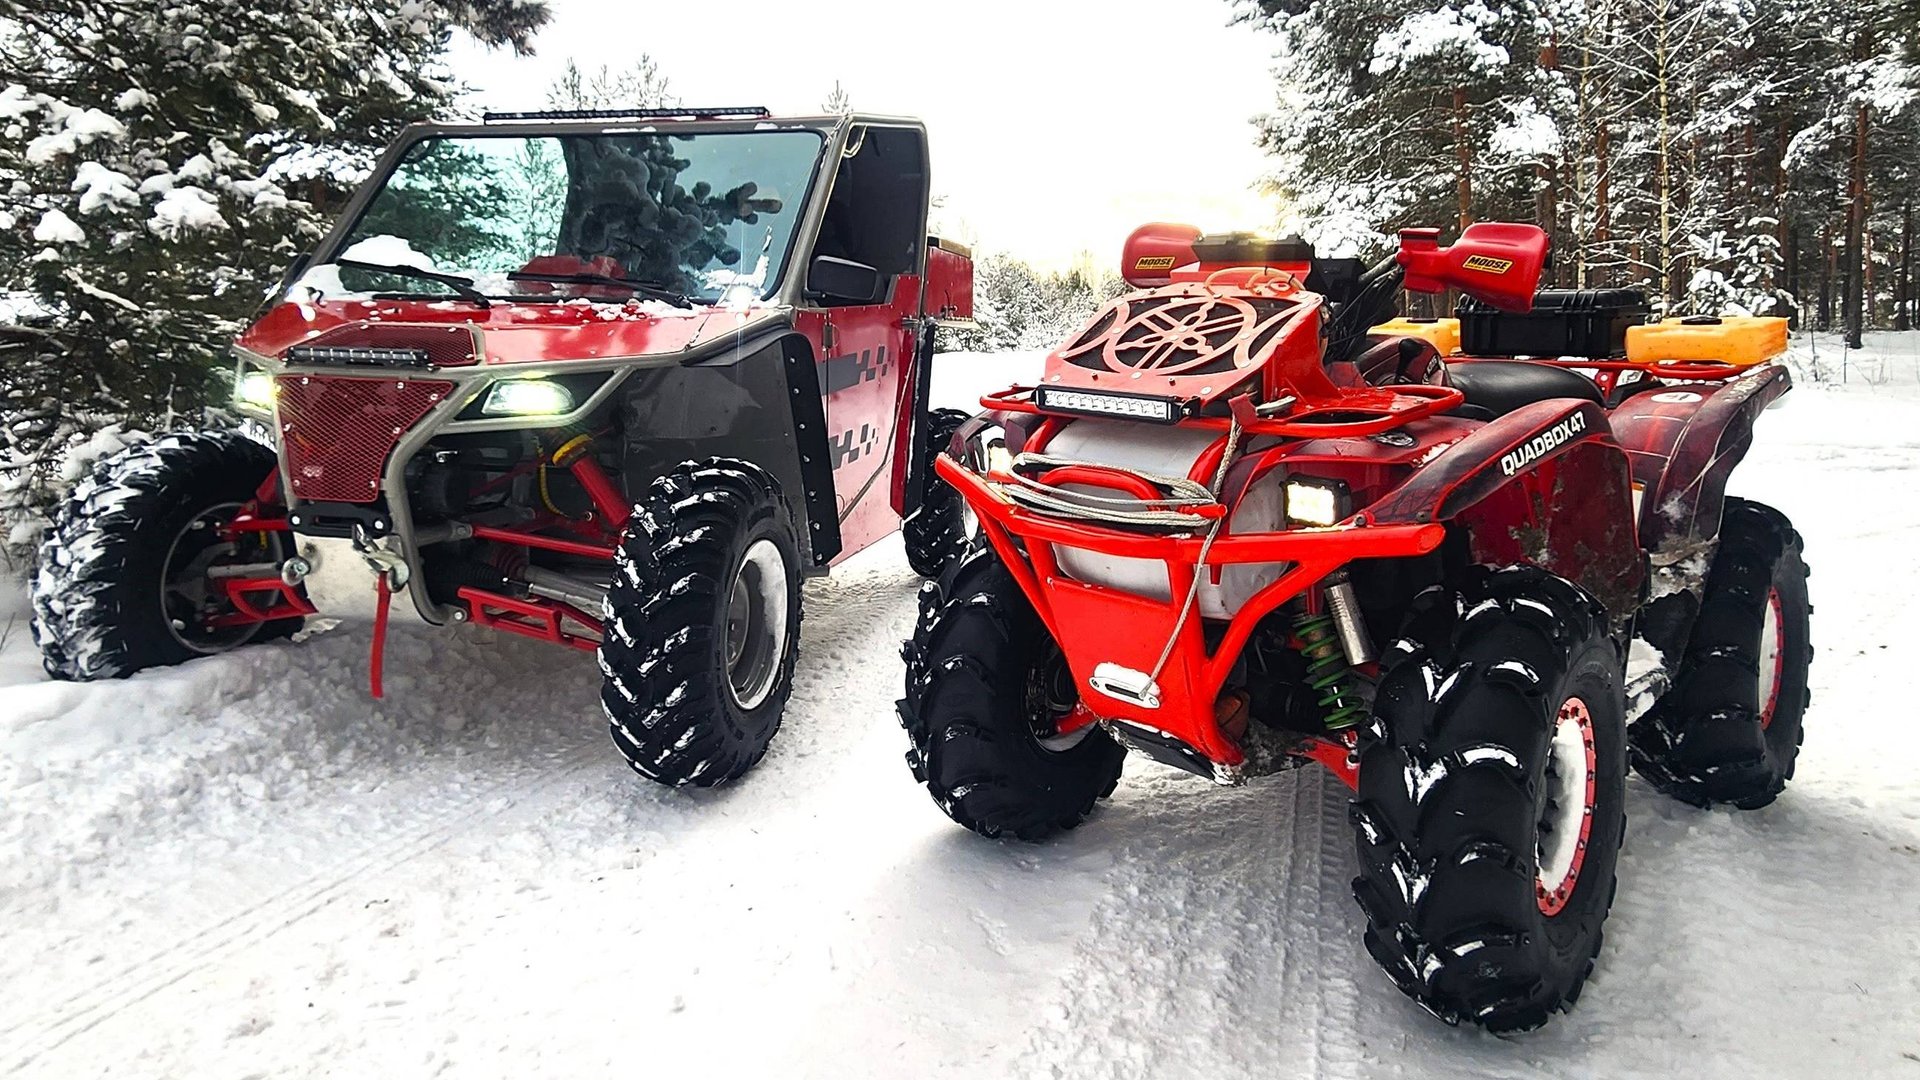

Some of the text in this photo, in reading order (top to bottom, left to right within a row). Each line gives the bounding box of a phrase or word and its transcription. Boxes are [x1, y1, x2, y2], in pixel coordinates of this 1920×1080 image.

[1138, 258, 1173, 266] MOOSE
[1467, 256, 1510, 270] MOOSE
[1500, 411, 1586, 476] QUADBOX47
